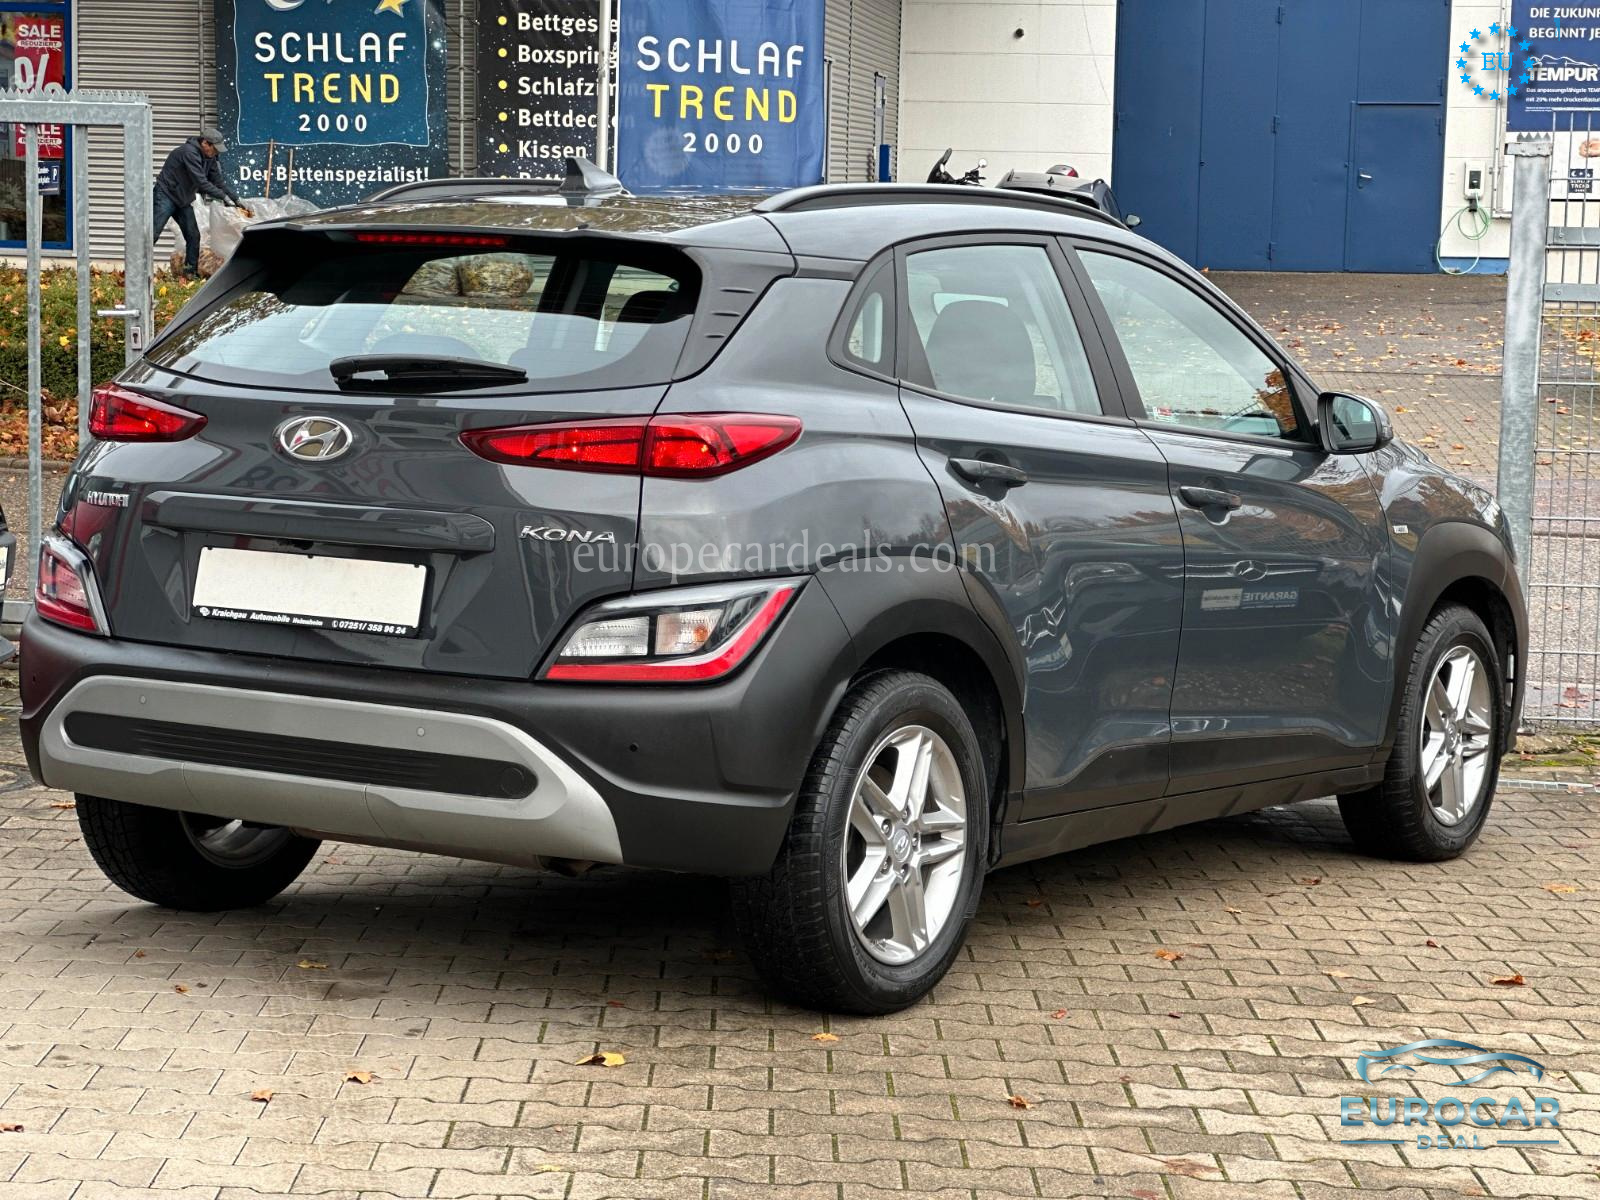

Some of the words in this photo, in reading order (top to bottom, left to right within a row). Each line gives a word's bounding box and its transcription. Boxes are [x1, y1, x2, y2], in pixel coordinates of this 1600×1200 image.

[1530, 7, 1550, 18] DIE
[18, 24, 61, 38] SALE
[517, 12, 618, 36] Bettgese
[1529, 27, 1586, 38] BEGINNT
[254, 31, 408, 63] SCHLAF
[636, 35, 804, 78] SCHLAF
[1528, 67, 1598, 81] TEMPUR
[264, 72, 400, 103] TREND
[646, 83, 797, 123] TREND
[19, 123, 61, 135] SLE
[298, 113, 368, 132] 2000
[518, 140, 587, 158] Kissen
[683, 132, 764, 154] 2000
[240, 166, 268, 181] Der
[276, 166, 430, 185] Bettenspezialist!
[87, 490, 130, 507] HYUNDAI
[519, 525, 616, 544] KONA
[211, 608, 248, 620] Kraichgau
[249, 612, 291, 623] Automobile
[338, 620, 368, 631] 07251/
[367, 623, 383, 632] 358
[395, 626, 407, 635] 24
